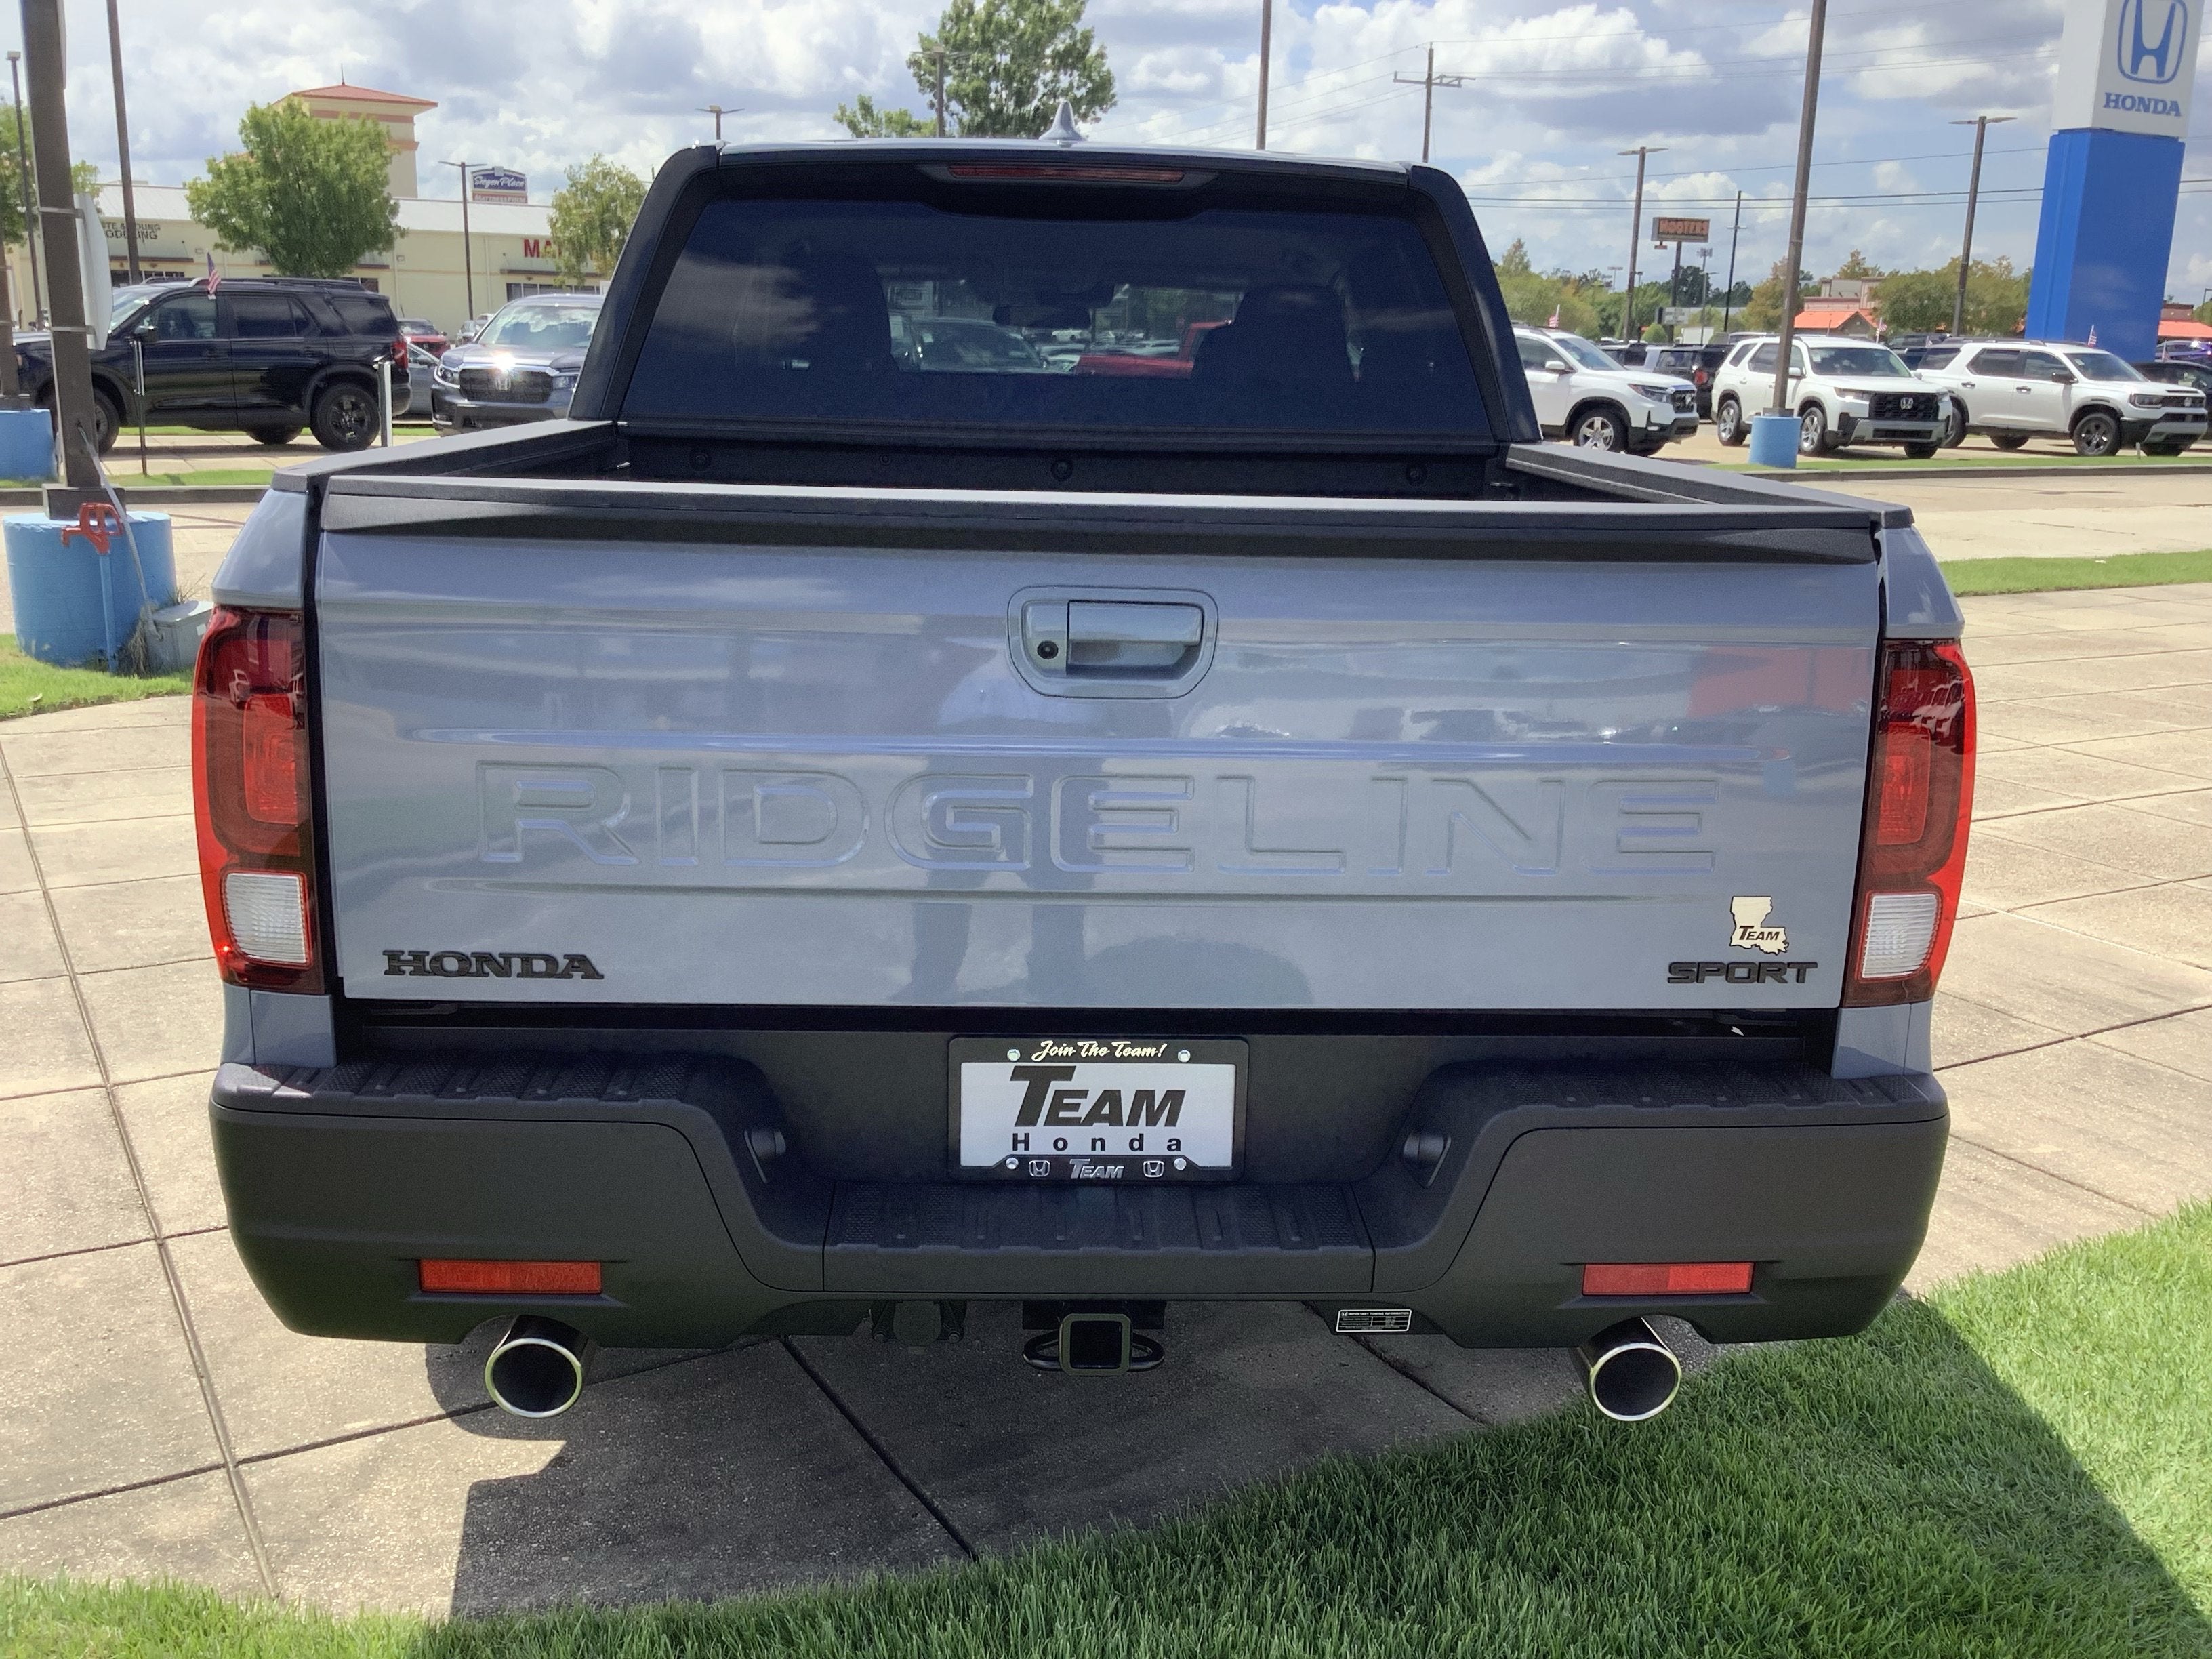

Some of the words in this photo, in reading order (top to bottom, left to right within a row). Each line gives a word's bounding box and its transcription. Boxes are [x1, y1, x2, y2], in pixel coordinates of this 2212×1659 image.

[2103, 91, 2182, 117] HONDA
[499, 176, 525, 188] Place
[1658, 220, 1708, 235] HOOTERS
[476, 760, 1720, 876] RIDGELINE
[382, 950, 605, 980] HONDA
[1667, 962, 1818, 983] SPORT
[1031, 1040, 1076, 1062] Join
[1076, 1041, 1111, 1058] The
[1111, 1041, 1168, 1059] Team!
